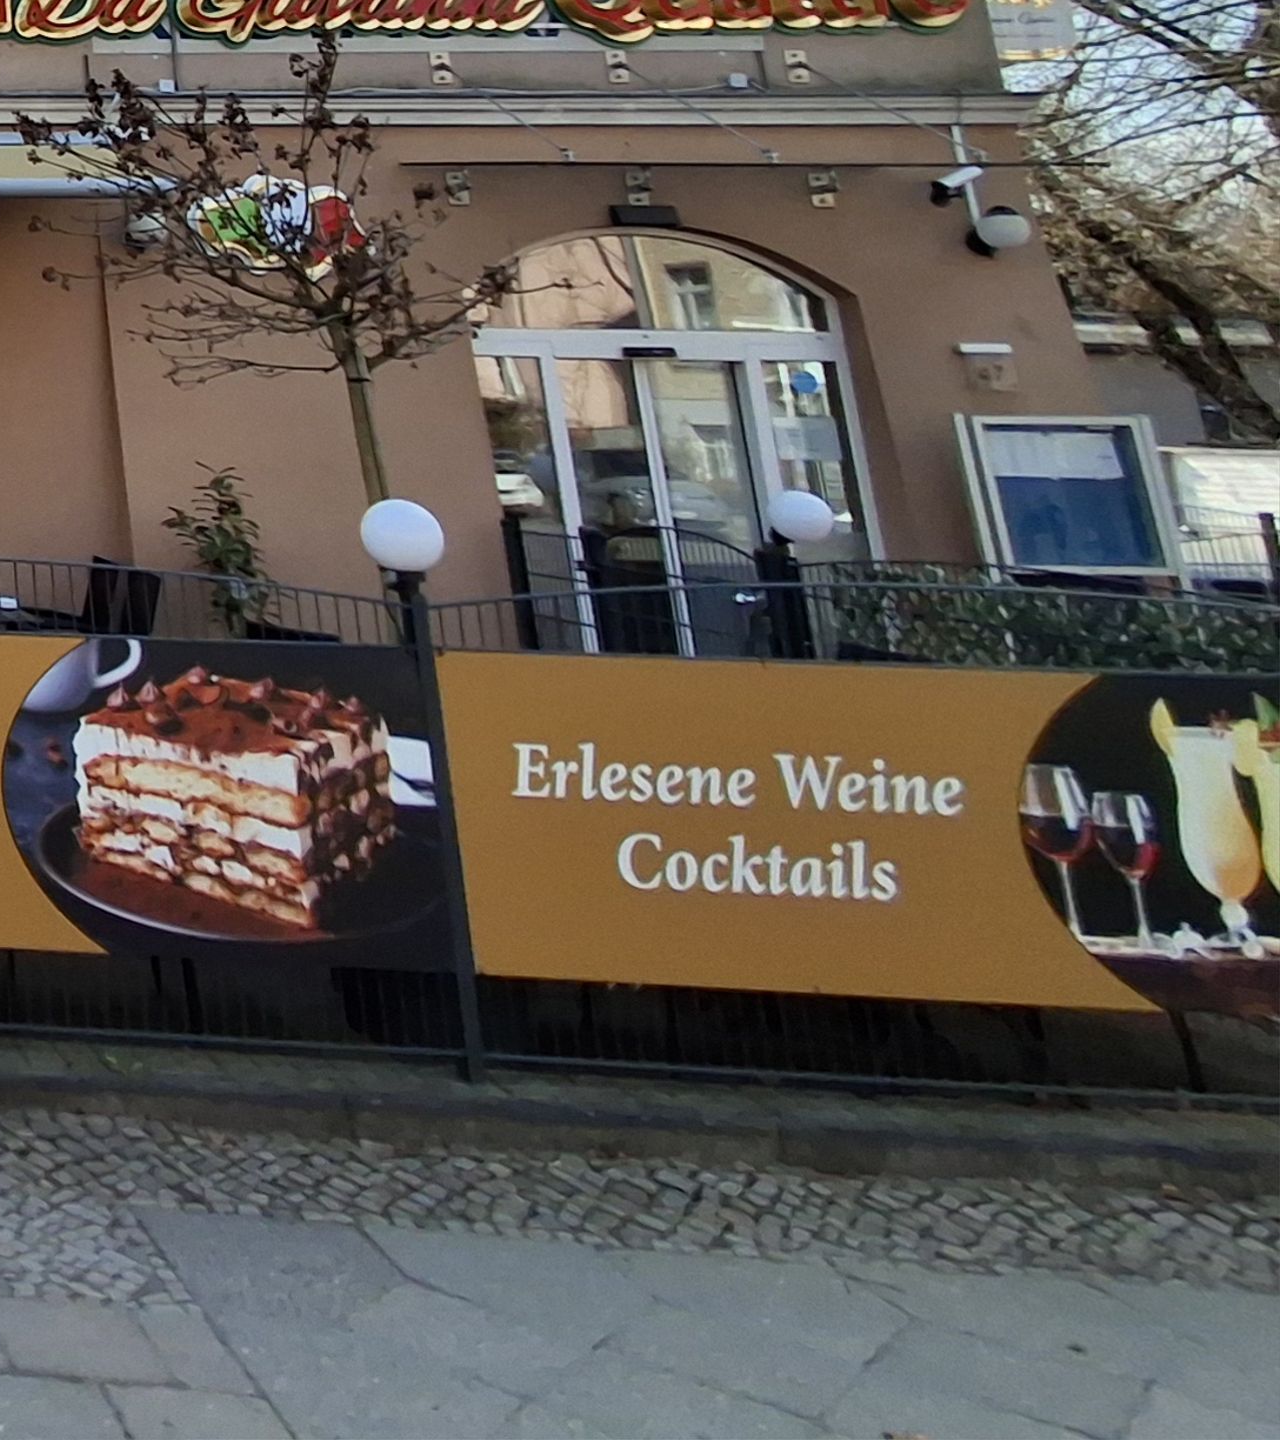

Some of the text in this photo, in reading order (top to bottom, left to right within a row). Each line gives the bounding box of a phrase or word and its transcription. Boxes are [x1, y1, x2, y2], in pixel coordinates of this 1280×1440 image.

[510, 741, 966, 818] Erlesene Weine
[616, 831, 900, 903] Cocktails
